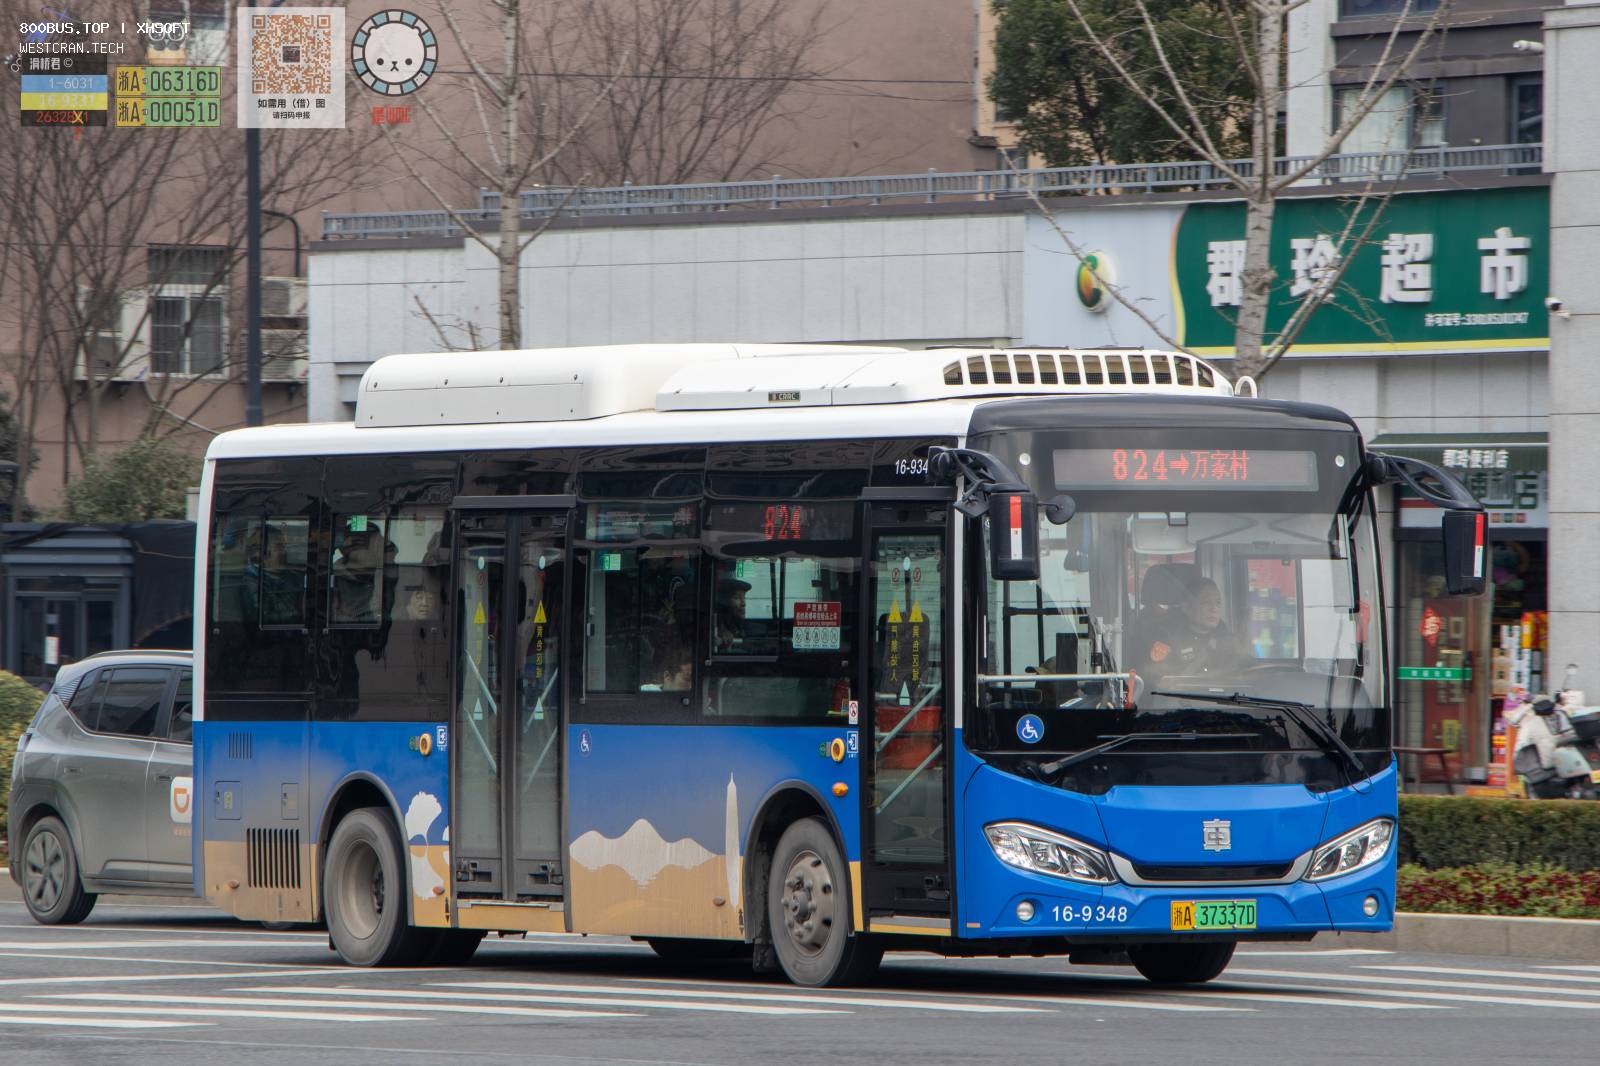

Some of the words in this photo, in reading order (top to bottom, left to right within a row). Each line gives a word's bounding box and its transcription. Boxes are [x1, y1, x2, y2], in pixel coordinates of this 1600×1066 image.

[895, 458, 929, 475] 16-934
[1112, 449, 1169, 481] 824
[1191, 449, 1249, 481] 万家村
[764, 504, 801, 540] 824
[1052, 905, 1128, 922] 16-9348
